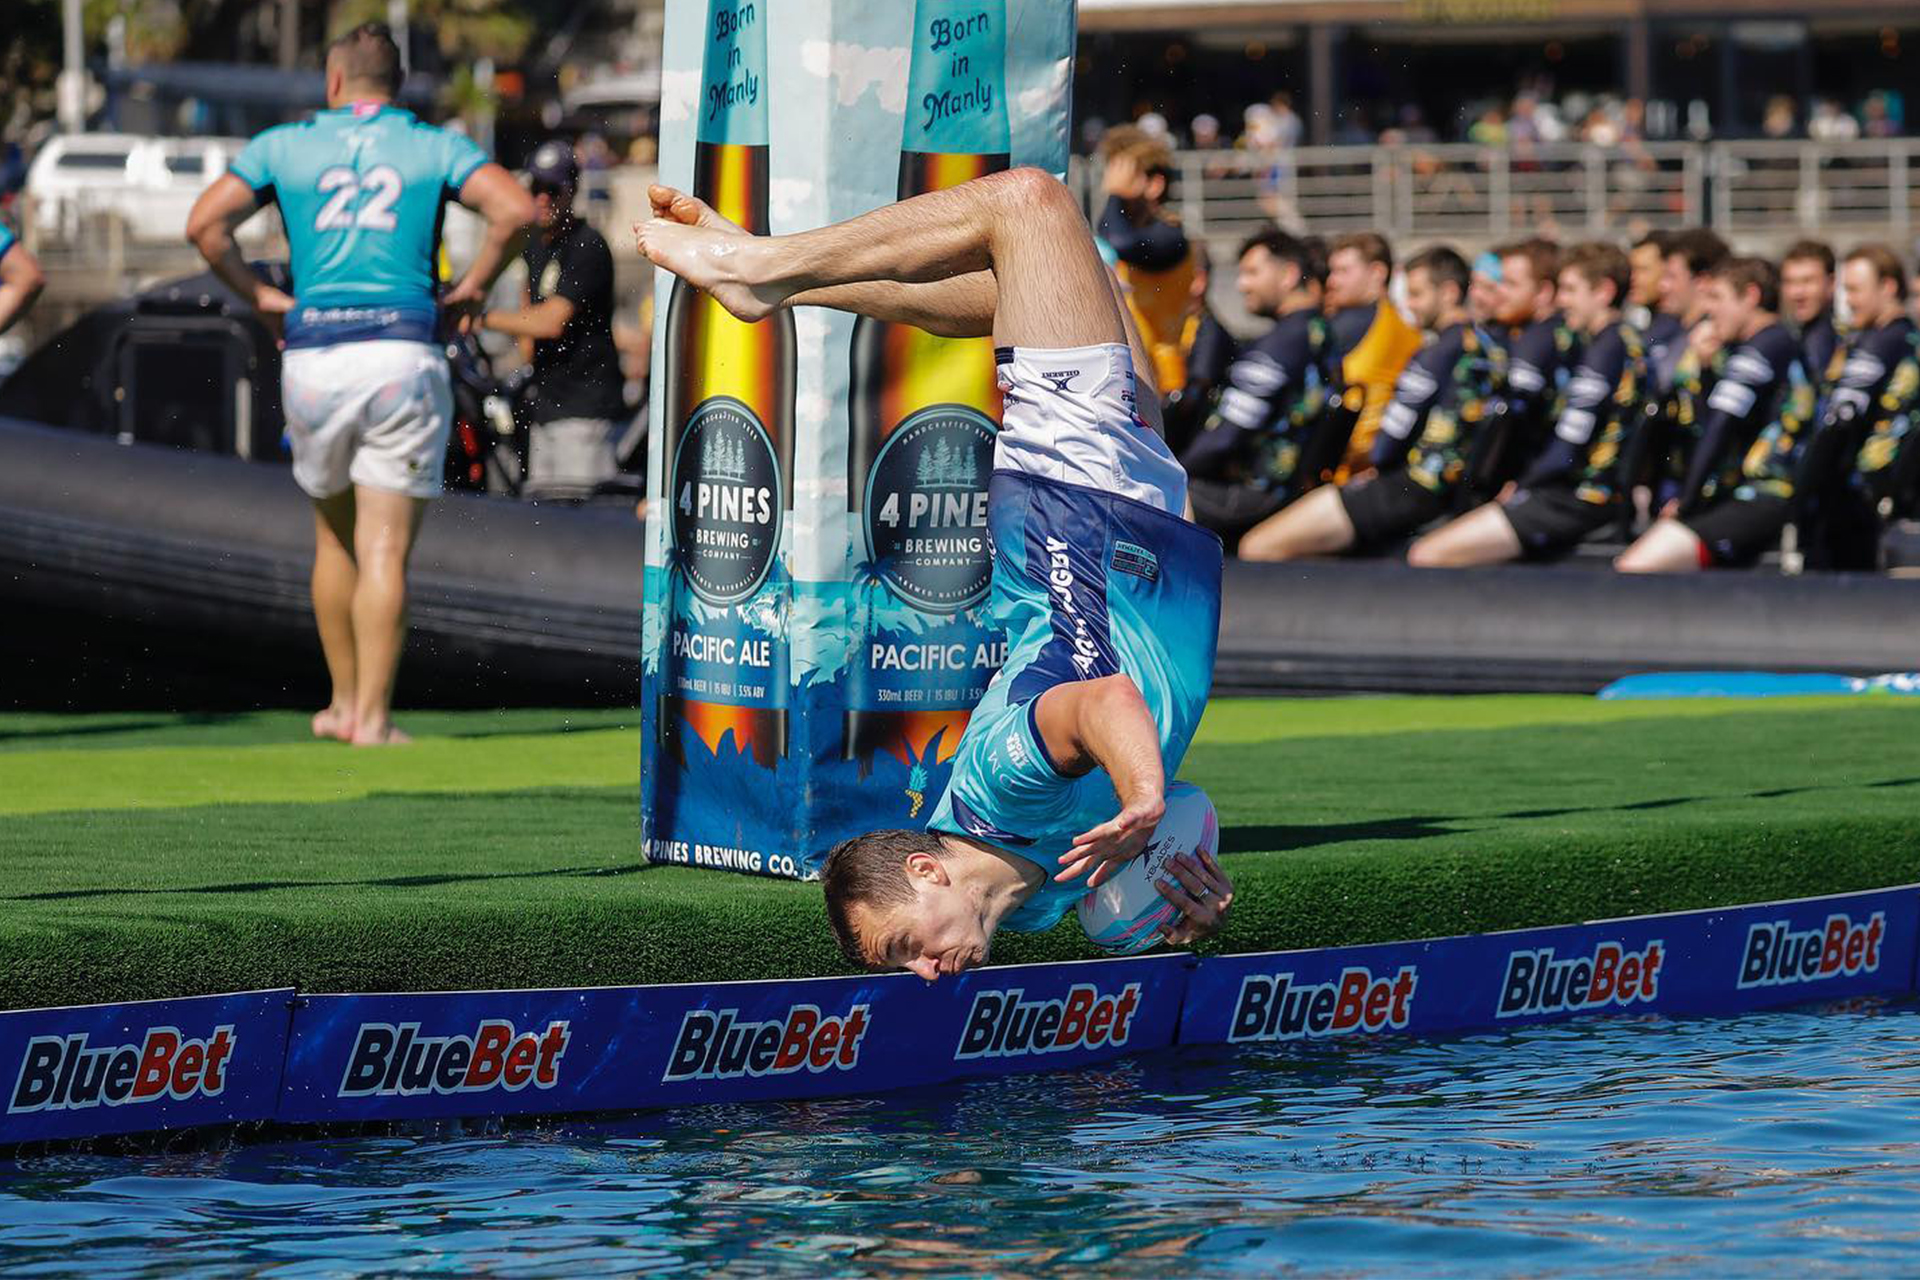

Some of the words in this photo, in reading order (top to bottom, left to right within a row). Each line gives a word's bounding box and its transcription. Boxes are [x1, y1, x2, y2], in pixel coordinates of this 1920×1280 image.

[716, 3, 755, 41] Born
[930, 12, 988, 51] Born
[727, 43, 741, 69] in
[951, 52, 969, 77] in
[709, 67, 758, 121] Manly
[923, 77, 991, 131] Manly
[314, 165, 402, 233] 22
[679, 481, 693, 516] 4
[697, 483, 771, 525] PINES
[879, 492, 900, 528] 4
[696, 528, 749, 549] BREWING
[702, 549, 741, 561] COMPANY
[905, 538, 982, 554] BREWING
[915, 558, 971, 566] COMPANY
[673, 630, 736, 666] PACIFIC
[739, 640, 771, 668] ALE
[871, 643, 967, 671] PACIFIC
[904, 689, 923, 701] BEER
[653, 840, 690, 864] PINES
[694, 844, 762, 872] BREWING
[767, 854, 799, 877] CO.
[1144, 834, 1176, 882] XBLADES
[1737, 912, 1886, 990] BlueBet
[1496, 939, 1665, 1018] BlueBet
[954, 983, 1142, 1060] BlueBet
[1227, 965, 1417, 1043] BlueBet
[338, 1020, 570, 1097] BlueBet
[662, 1004, 870, 1081] BlueBet
[7, 1024, 235, 1113] BlueBet
